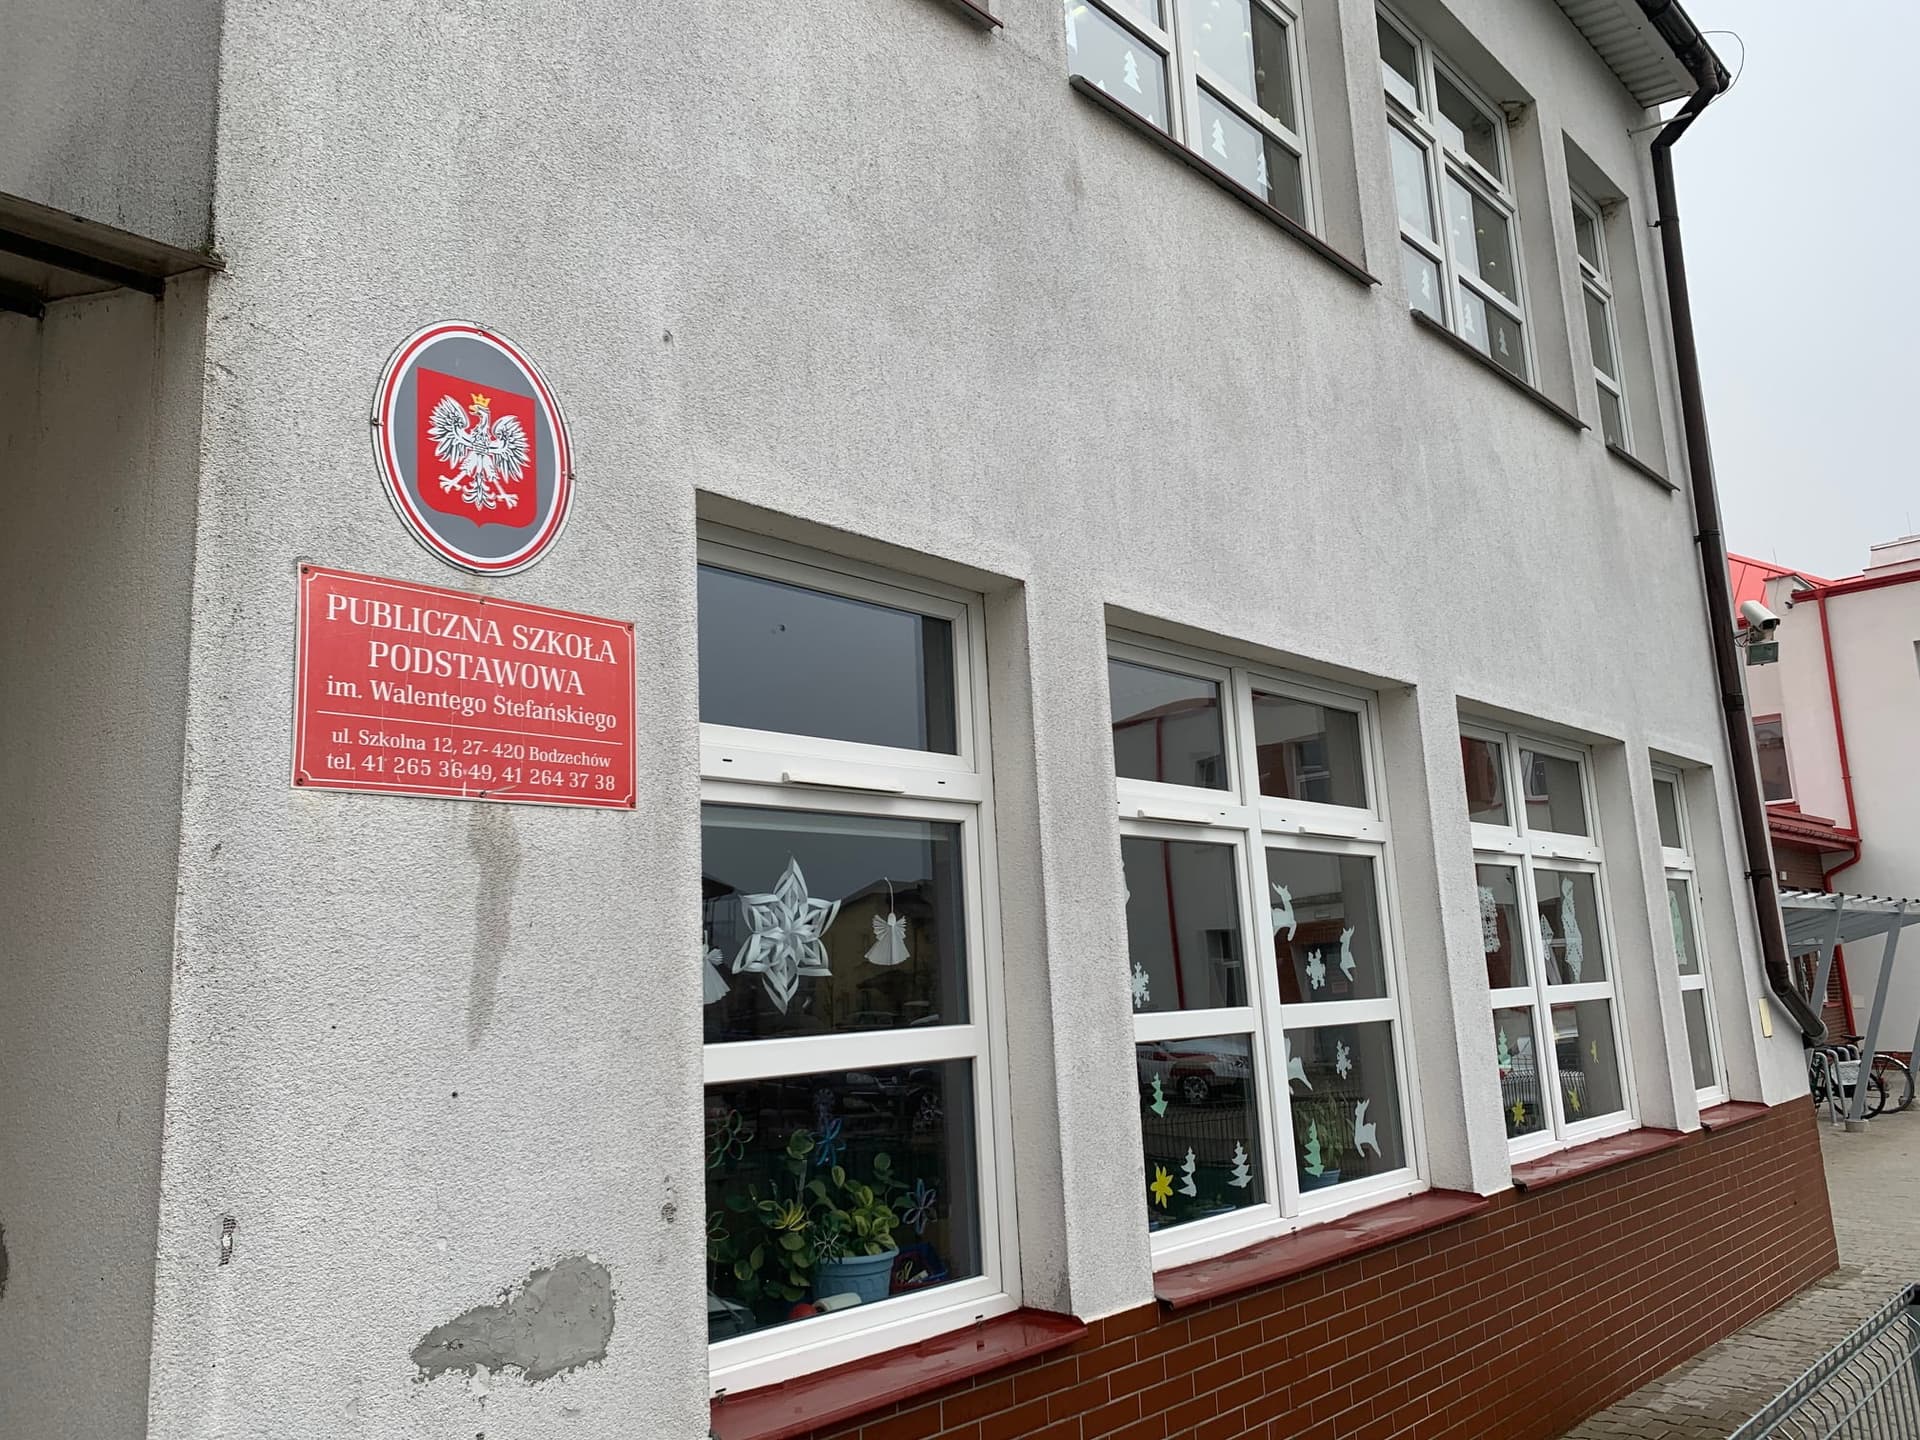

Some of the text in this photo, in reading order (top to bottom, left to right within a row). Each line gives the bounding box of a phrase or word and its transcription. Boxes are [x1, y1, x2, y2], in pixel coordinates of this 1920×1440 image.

[326, 593, 618, 665] PUBLICZNA SZKOŁA
[367, 640, 585, 696] PODSTAWOWA
[326, 675, 617, 732] im. Walentego Stefańskiego
[326, 752, 616, 791] tel. 41 265 36 49, 41 264 37 38
[331, 727, 612, 767] ul. Szkolna 12, 27-420 Bodzechów
